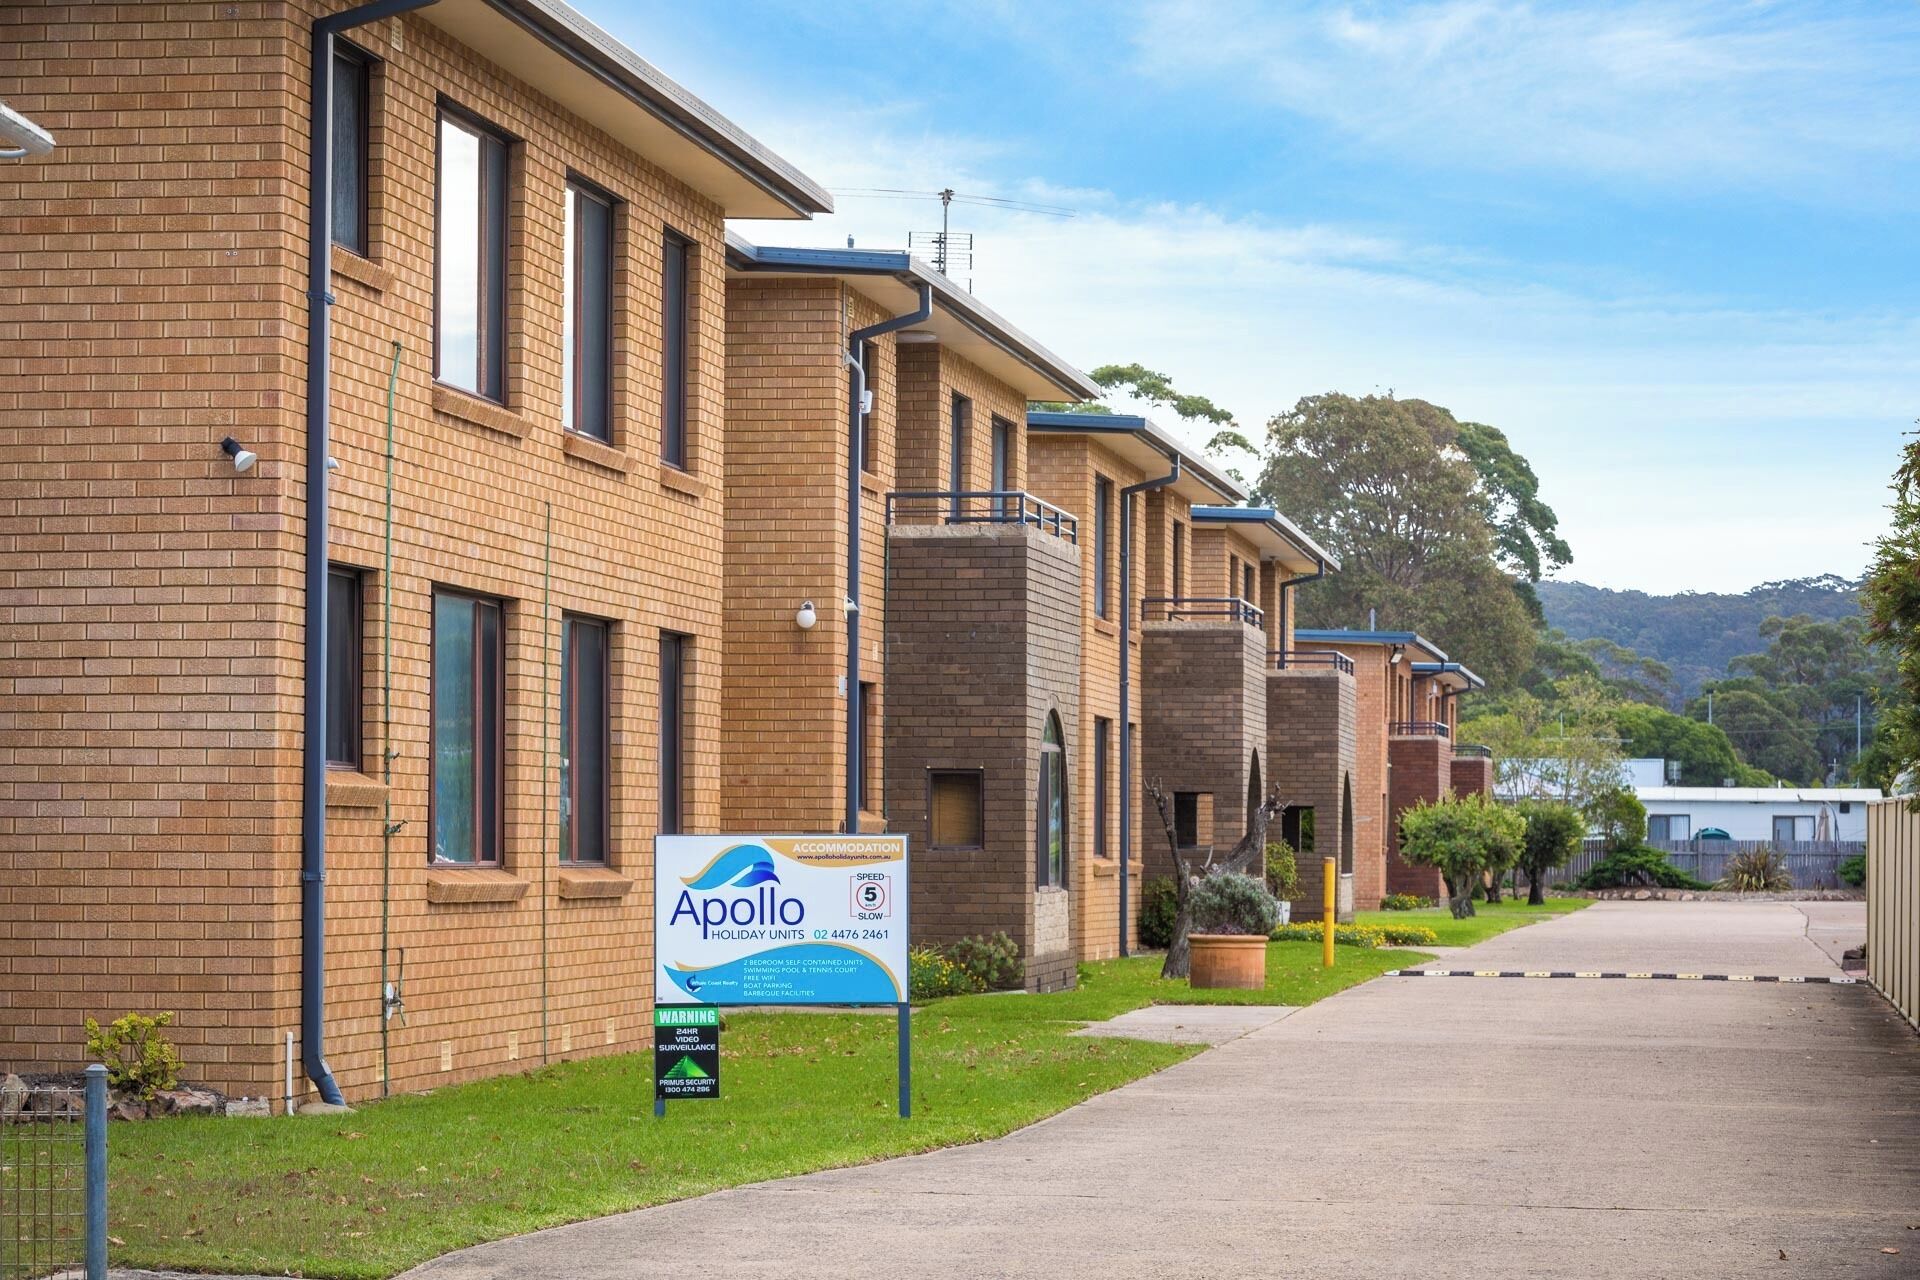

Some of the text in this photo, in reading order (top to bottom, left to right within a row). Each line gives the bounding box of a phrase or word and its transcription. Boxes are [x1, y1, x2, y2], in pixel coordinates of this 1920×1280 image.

[793, 843, 900, 853] ACCOMMODATION
[864, 887, 876, 901] 5
[670, 886, 804, 939] Apollo
[712, 930, 804, 939] HOLIDAY UNITS
[814, 929, 889, 939] 02 4476 2461
[659, 1010, 715, 1023] WARNING
